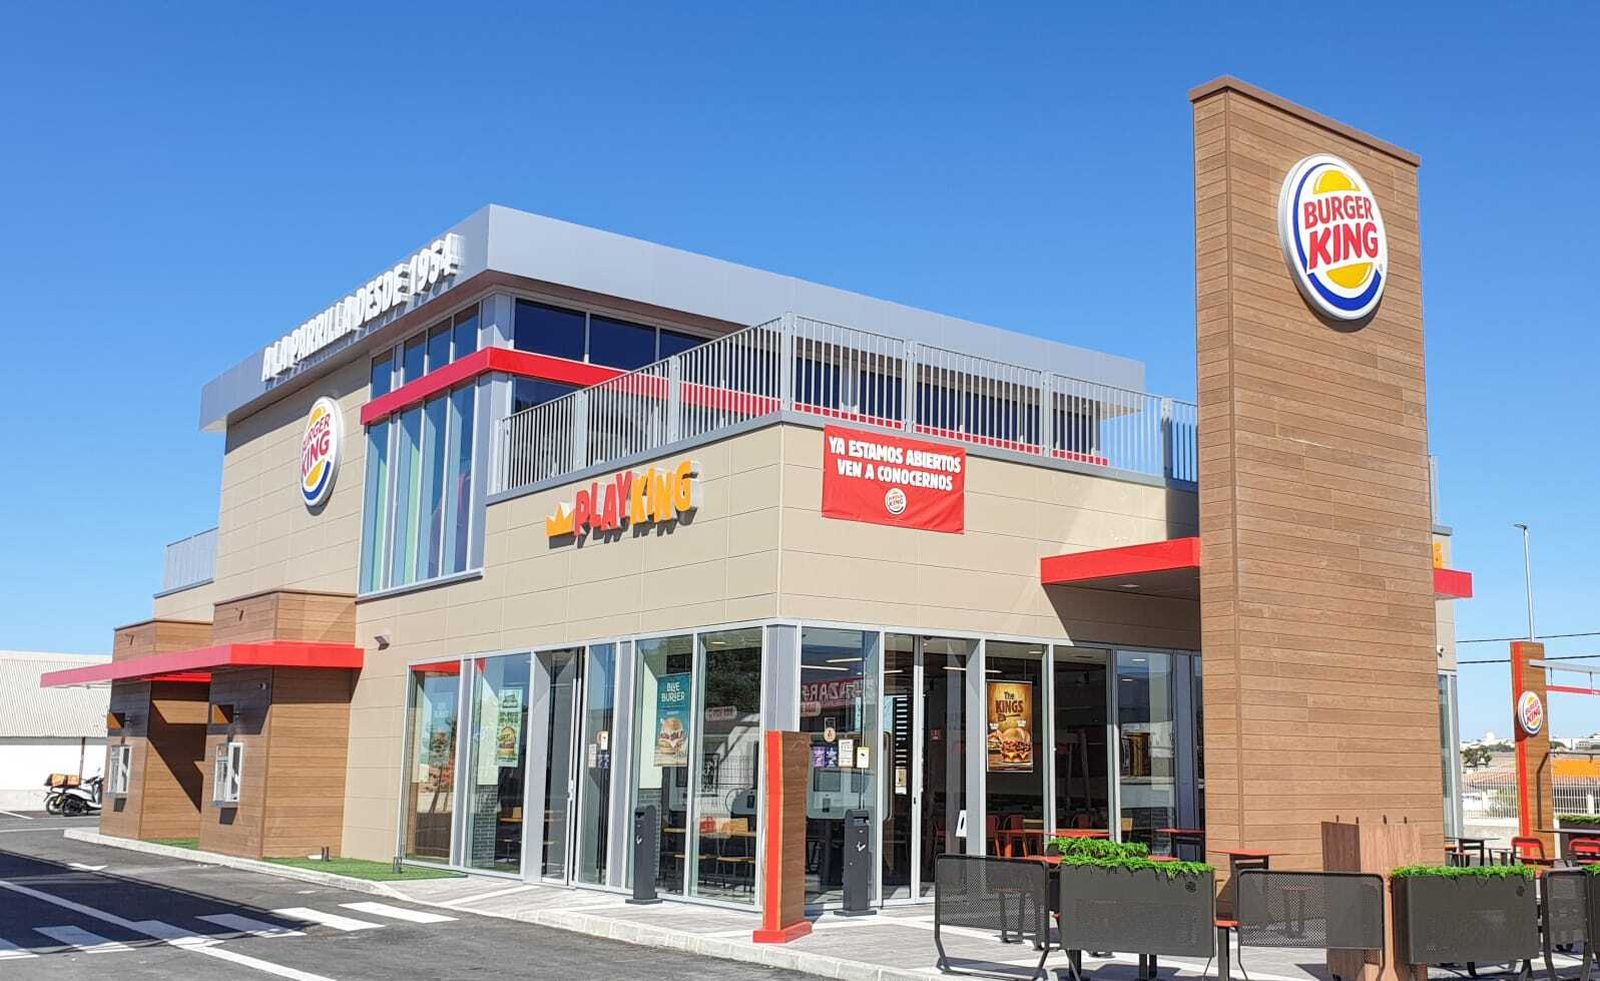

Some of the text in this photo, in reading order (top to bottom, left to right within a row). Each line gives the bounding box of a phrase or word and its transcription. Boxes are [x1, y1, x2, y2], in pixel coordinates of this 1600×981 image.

[1304, 195, 1374, 230] BURGER
[1308, 222, 1379, 270] KING
[302, 430, 330, 477] KING
[829, 436, 962, 473] YA ESTAMOS ABIERTOS
[837, 459, 953, 491] VEN A CONOCERNOS
[661, 691, 685, 703] BURGER
[995, 700, 1023, 714] KINGS
[1004, 692, 1015, 700] The
